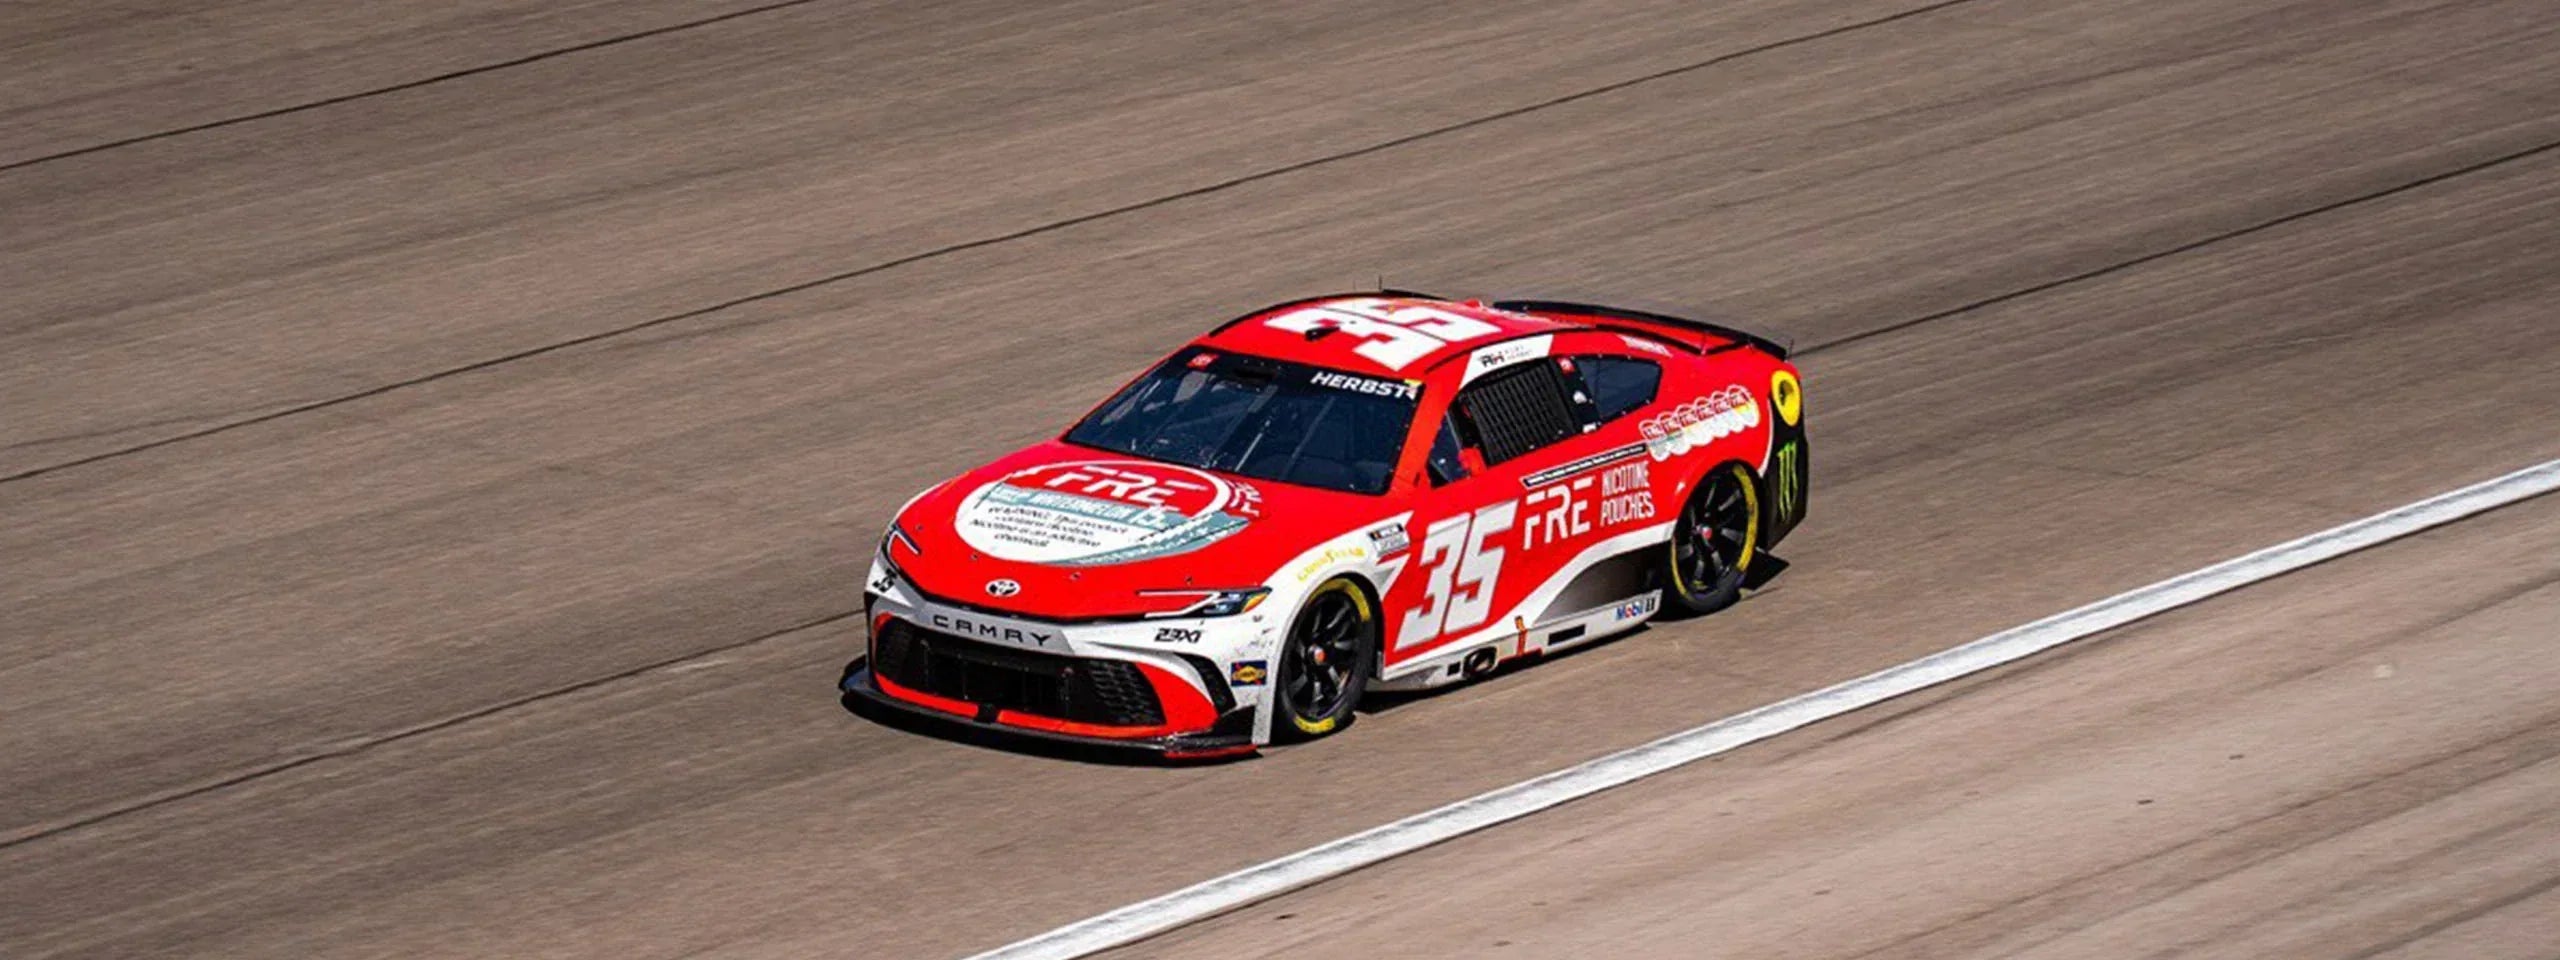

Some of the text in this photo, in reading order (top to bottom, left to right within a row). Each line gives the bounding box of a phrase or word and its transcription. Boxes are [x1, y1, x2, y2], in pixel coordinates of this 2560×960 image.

[1311, 372, 1409, 399] HERBST
[1046, 465, 1208, 506] FRE
[1602, 460, 1650, 497] NICOTINE
[1523, 476, 1596, 551] FRE
[1601, 491, 1656, 527] POUCHES
[1394, 498, 1520, 652] 35
[932, 614, 1052, 647] CAMRY
